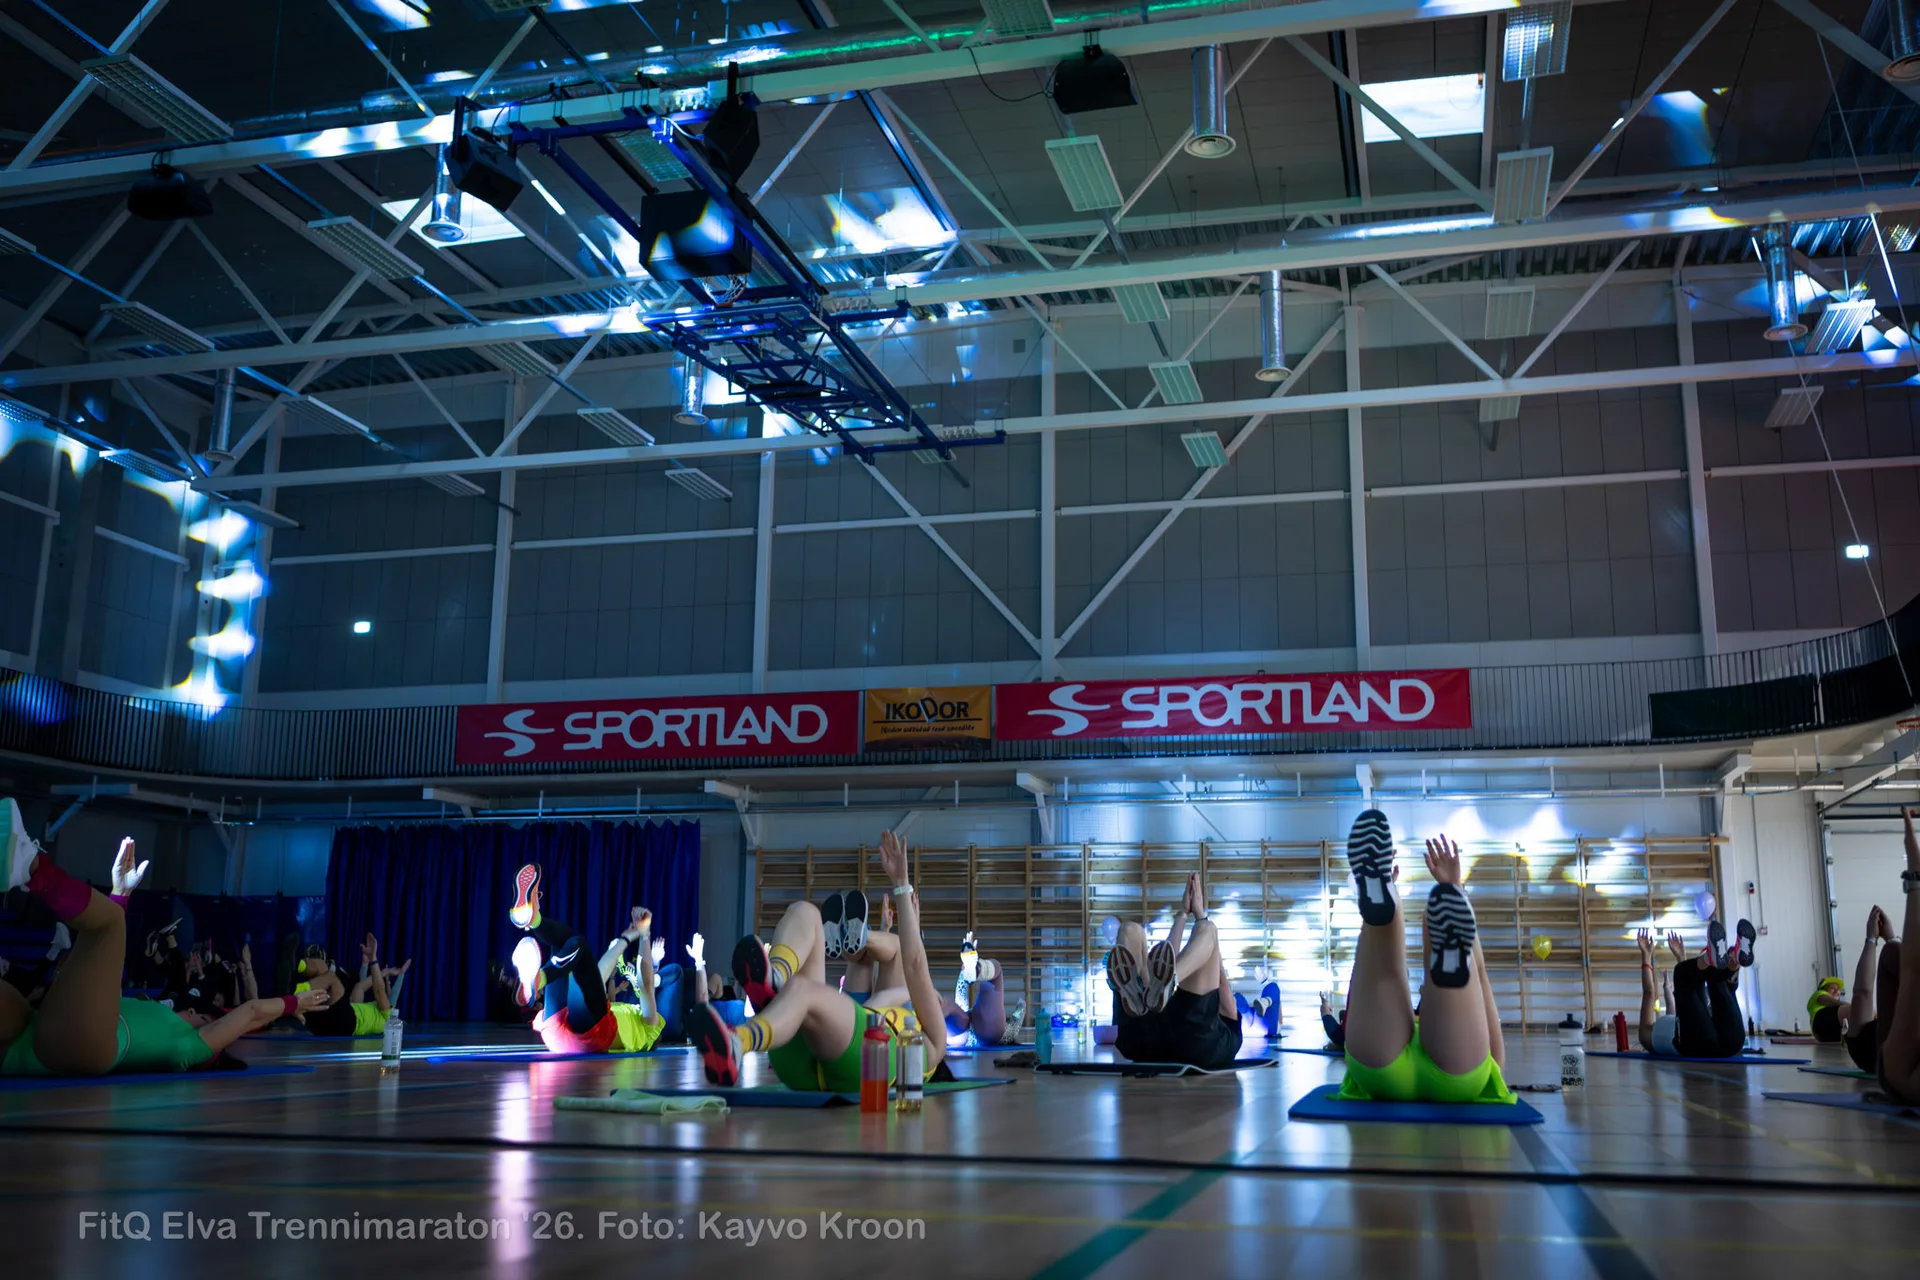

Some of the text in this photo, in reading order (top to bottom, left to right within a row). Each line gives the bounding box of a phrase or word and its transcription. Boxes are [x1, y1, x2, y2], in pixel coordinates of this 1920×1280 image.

[563, 703, 829, 751] SPORTLAND
[885, 697, 969, 721] IKODOR
[1121, 679, 1435, 728] SPORTLAND
